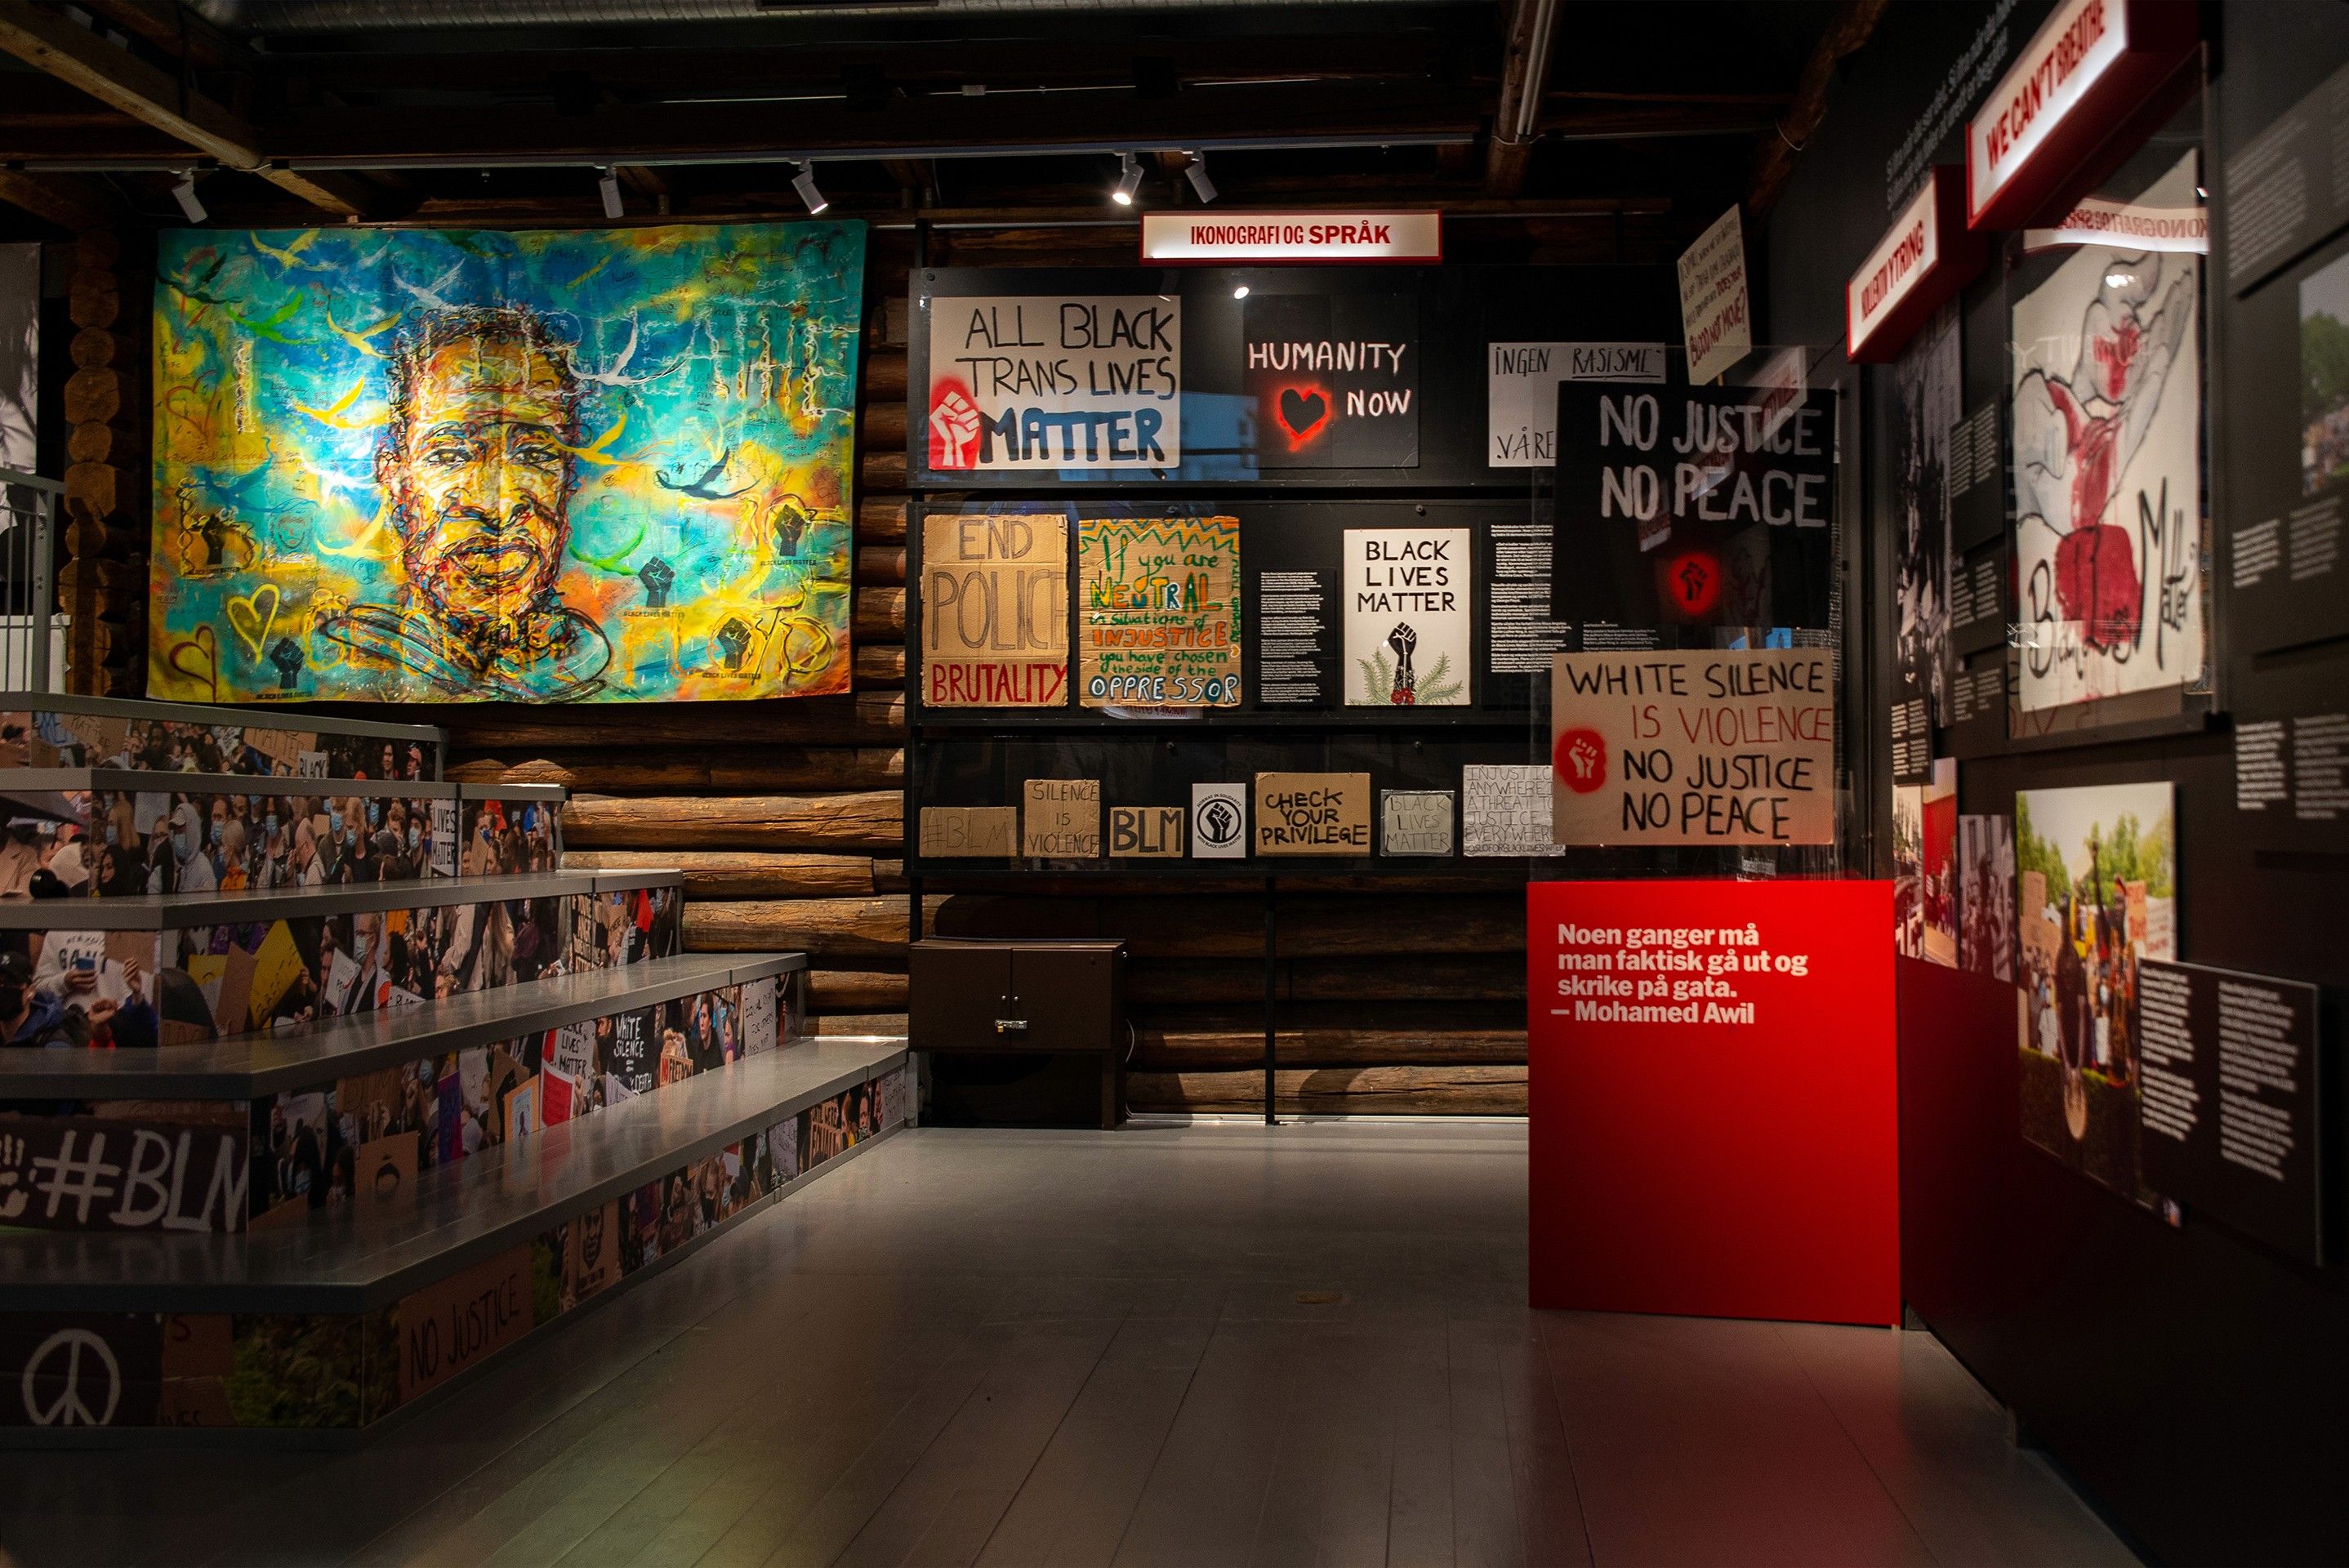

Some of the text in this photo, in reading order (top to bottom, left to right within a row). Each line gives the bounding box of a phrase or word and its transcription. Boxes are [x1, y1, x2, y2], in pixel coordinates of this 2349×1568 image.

[1986, 110, 2008, 171] WE
[1190, 220, 1391, 245] IKONOGRAFI OG SPRÅK
[965, 302, 1174, 352] ALL BLACK
[956, 355, 1177, 401] TRANS LIVES
[1249, 341, 1411, 418] HUMANITY NOW
[978, 408, 1166, 464] MATTER
[1599, 394, 1660, 452] NO
[1673, 400, 1822, 455] JUSTICE
[1601, 462, 1826, 528] NO PEACE
[959, 519, 1032, 560] END
[1366, 540, 1451, 561] BLACK
[1103, 532, 1219, 583] If you are
[1366, 566, 1449, 587] LIVES
[1090, 572, 1223, 612] NEUTRAL
[1357, 591, 1455, 612] MATTER
[931, 568, 1068, 652] POLICE
[1192, 613, 1209, 632] of
[1092, 621, 1228, 648] INJUSTICE
[1099, 650, 1227, 673] you have chosen
[1112, 662, 1217, 676] the side of the
[931, 662, 1068, 703] BRUTALITY
[1089, 673, 1240, 703] OPPRESSOR
[1565, 661, 1825, 698] WHITE SILENCE
[1631, 704, 1832, 746] IS VIOLENCE
[1466, 766, 1552, 780] INJUSTIC
[1622, 749, 1813, 791] NO JUSTICE
[1032, 782, 1099, 802] SILENCE
[1265, 788, 1343, 809] CHECK
[1468, 782, 1545, 795] ANYWHERE
[1390, 795, 1446, 812] BLACK
[1468, 796, 1478, 809] A
[1478, 795, 1534, 810] THREAT
[1621, 791, 1790, 840] NO PEACE
[433, 807, 457, 834] LIVES
[1055, 812, 1071, 826] IS
[1281, 807, 1339, 827] YOUR
[1397, 813, 1439, 831] LIVES
[1467, 811, 1540, 826] JUSTICE
[921, 815, 1008, 853] #BLM
[1113, 809, 1183, 853] BLM
[1261, 824, 1368, 846] PRIVILEGE
[1385, 831, 1451, 853] MATTER
[433, 840, 457, 865] MATTER
[1027, 834, 1099, 856] VIOLENCE
[1558, 922, 1759, 949] Noen ganger må
[1558, 948, 1808, 977] man faktisk gå ut og
[1558, 974, 1737, 1002] skrike på gata.
[1575, 1000, 1698, 1023] Mohamed
[1703, 1002, 1754, 1024] Awil
[616, 1014, 643, 1040] WHITE
[561, 1033, 580, 1054] LIVES
[613, 1039, 644, 1058] SILENCE
[559, 1054, 587, 1080] MATTER
[409, 1272, 520, 1387] NO JUSTICE
